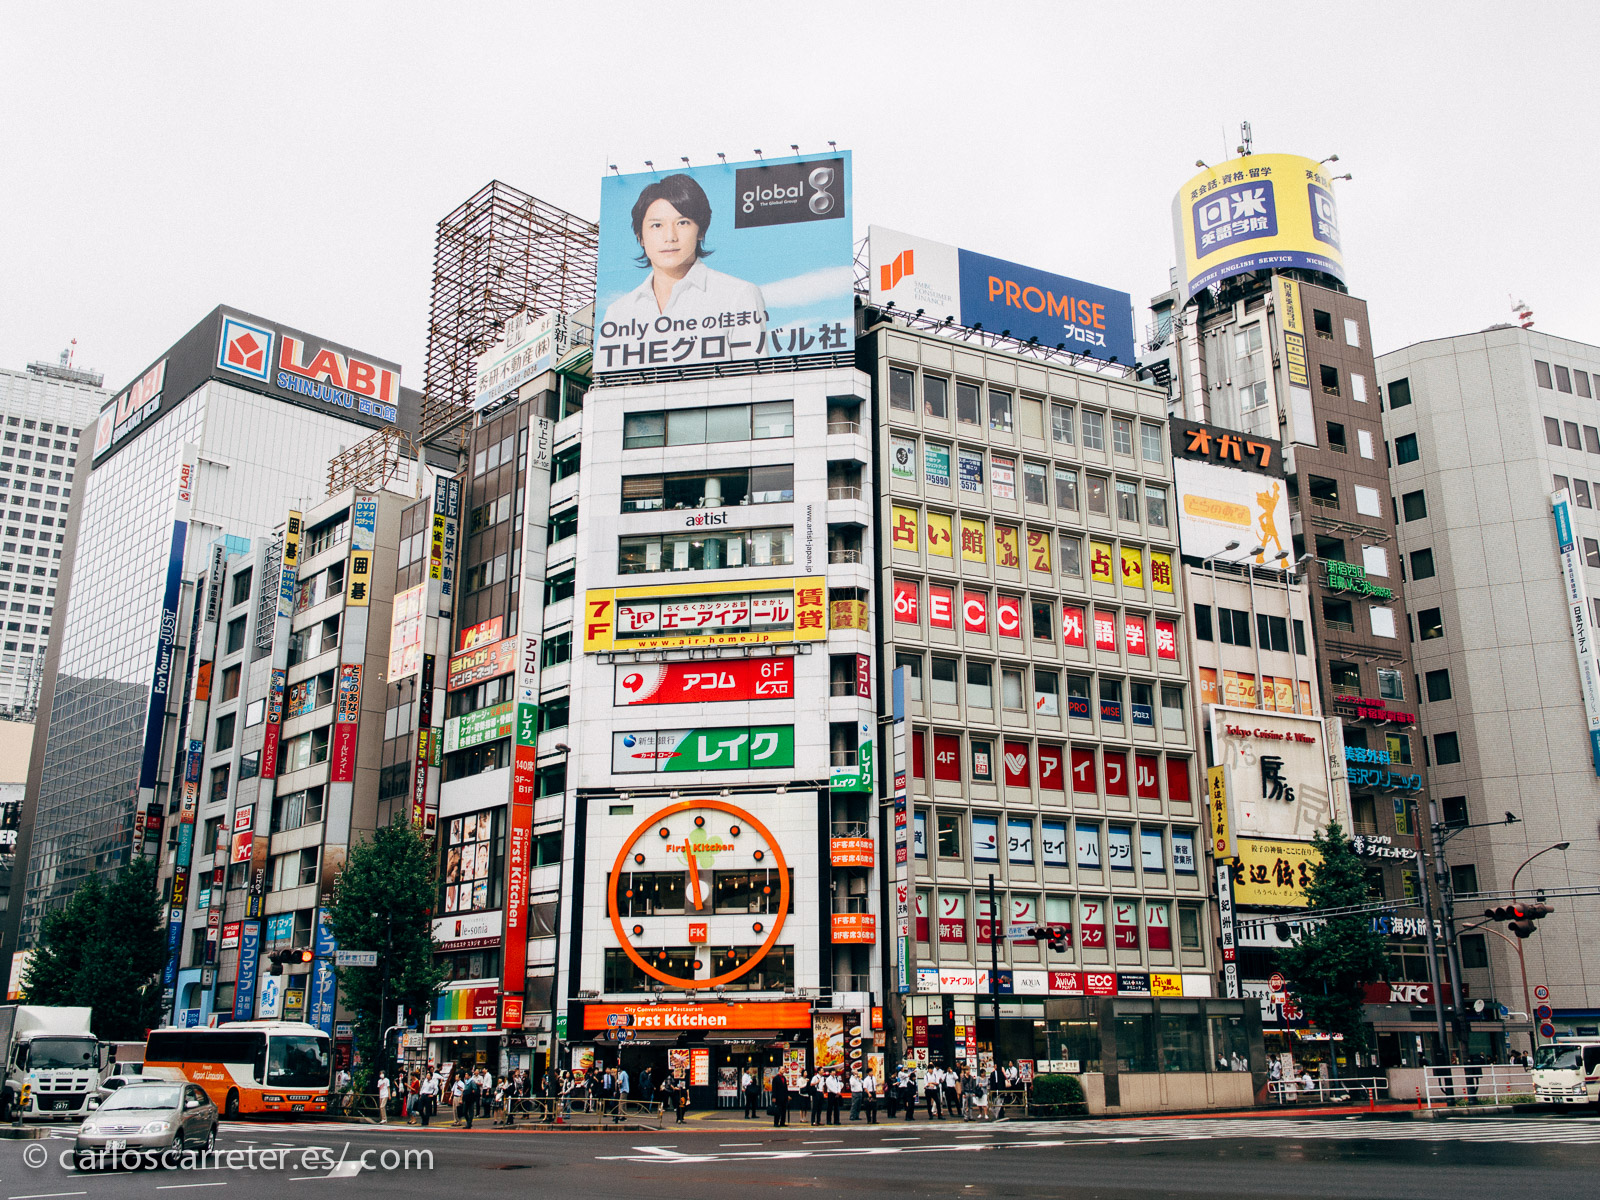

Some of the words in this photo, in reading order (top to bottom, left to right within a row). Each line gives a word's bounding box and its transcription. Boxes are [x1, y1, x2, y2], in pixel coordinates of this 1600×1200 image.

[1190, 166, 1273, 202] 英会話・資格・留学
[742, 181, 804, 214] global
[1198, 187, 1267, 232] 日米
[1201, 216, 1269, 249] 英語学院
[1191, 271, 1218, 293] NICHIBEI
[1220, 259, 1255, 275] ENGLISH
[1258, 255, 1293, 265] SERVICE
[914, 287, 952, 302] CONSUMER
[914, 294, 945, 307] FINANCE
[988, 275, 1106, 331] PROMISE
[600, 318, 649, 341] Only
[654, 316, 698, 334] One
[702, 310, 770, 330] の住まい
[1063, 324, 1107, 348] プロミス
[599, 322, 848, 368] THEグローバル社
[279, 335, 401, 404] LABI
[115, 358, 166, 428] LABI
[277, 371, 354, 409] SHINJUKU
[358, 397, 397, 424] 西口館
[537, 418, 549, 461] 村上ビル
[1186, 428, 1272, 468] オガワ
[180, 463, 191, 489] LABI
[356, 510, 374, 518] ビデオ
[1188, 498, 1247, 519] とらのあな
[286, 516, 300, 560] 囲碁
[433, 516, 444, 542] 麻雀
[805, 504, 813, 573] www.artist-japan.jp
[892, 514, 984, 555] 占い館
[442, 522, 456, 596] 秀研不動産
[1090, 549, 1171, 587] 占い館
[1328, 559, 1366, 579] 新宿西口
[281, 579, 293, 588] ビデオ
[283, 571, 294, 579] DVD
[351, 556, 368, 600] 囲碁
[662, 606, 790, 629] エーアイアール
[797, 587, 824, 630] 賃貸
[834, 601, 853, 628] 賃貸
[587, 600, 611, 641] 7F
[894, 590, 917, 615] 6F
[930, 594, 1019, 631] ECC
[1063, 614, 1174, 652] 外語学院
[638, 633, 770, 648] www.air-home.jp
[451, 648, 489, 675] まんが
[524, 638, 537, 674] アコム
[450, 662, 499, 688] インターネット
[683, 671, 736, 691] アコム
[760, 662, 785, 678] 6F
[858, 657, 869, 696] アコム
[348, 664, 361, 712] とらのあな
[770, 685, 788, 695] 入口
[1200, 680, 1216, 692] 6F
[1224, 680, 1288, 701] とらのあな
[338, 692, 348, 714] 新宿店
[521, 708, 533, 740] レイク
[1132, 711, 1151, 720] プロミス
[190, 741, 202, 750] 6F
[638, 735, 675, 746] 新生銀行
[1225, 725, 1252, 738] Tokyo
[1253, 728, 1284, 742] Cuisine
[1285, 732, 1293, 742] &
[1294, 732, 1316, 745] Wine
[265, 732, 276, 772] ワールドメイト
[340, 732, 350, 775] ワールドメイト
[641, 751, 674, 760] カードローン
[697, 733, 779, 763] レイク
[1344, 746, 1391, 765] 美容外科
[515, 760, 534, 772] 140席
[861, 749, 871, 785] レイク
[936, 752, 955, 764] 4F
[1041, 756, 1155, 787] アイフル
[518, 785, 533, 794] B1F
[895, 777, 906, 785] ECC
[1260, 755, 1295, 802] 房's
[1346, 767, 1422, 790] 吉沢クリニック
[1213, 775, 1225, 836] 老辺餃子館
[510, 827, 523, 864] First
[693, 843, 735, 853] Kitchen
[1174, 845, 1189, 855] 新宿
[1367, 835, 1392, 845] ミスパリ
[1173, 853, 1193, 865] 営業所
[1232, 856, 1314, 890] 老辺餃子
[173, 874, 185, 903] トレカ
[508, 865, 522, 929] Kitchen
[897, 904, 908, 915] 天狗
[1084, 902, 1164, 925] アビバ
[461, 923, 488, 936] le-sonia
[689, 927, 706, 938] FK
[939, 924, 963, 938] 新宿
[1220, 899, 1233, 946] 紀州屋
[240, 937, 257, 991] ソフマップ
[1224, 950, 1234, 959] 2F
[949, 976, 975, 986] アイフル
[1020, 978, 1041, 987] AQUA
[1087, 975, 1113, 986] ECC
[243, 995, 251, 1010] 新宿
[1389, 985, 1429, 1003] KFC
[1537, 988, 1547, 997] 40
[321, 1003, 332, 1023] 新宿
[623, 1006, 636, 1014] City
[632, 1013, 661, 1027] irst
[664, 1013, 727, 1027] Kitchen
[557, 1018, 567, 1026] レイク
[192, 1070, 206, 1080] Airport
[205, 1071, 225, 1081] Limousine
